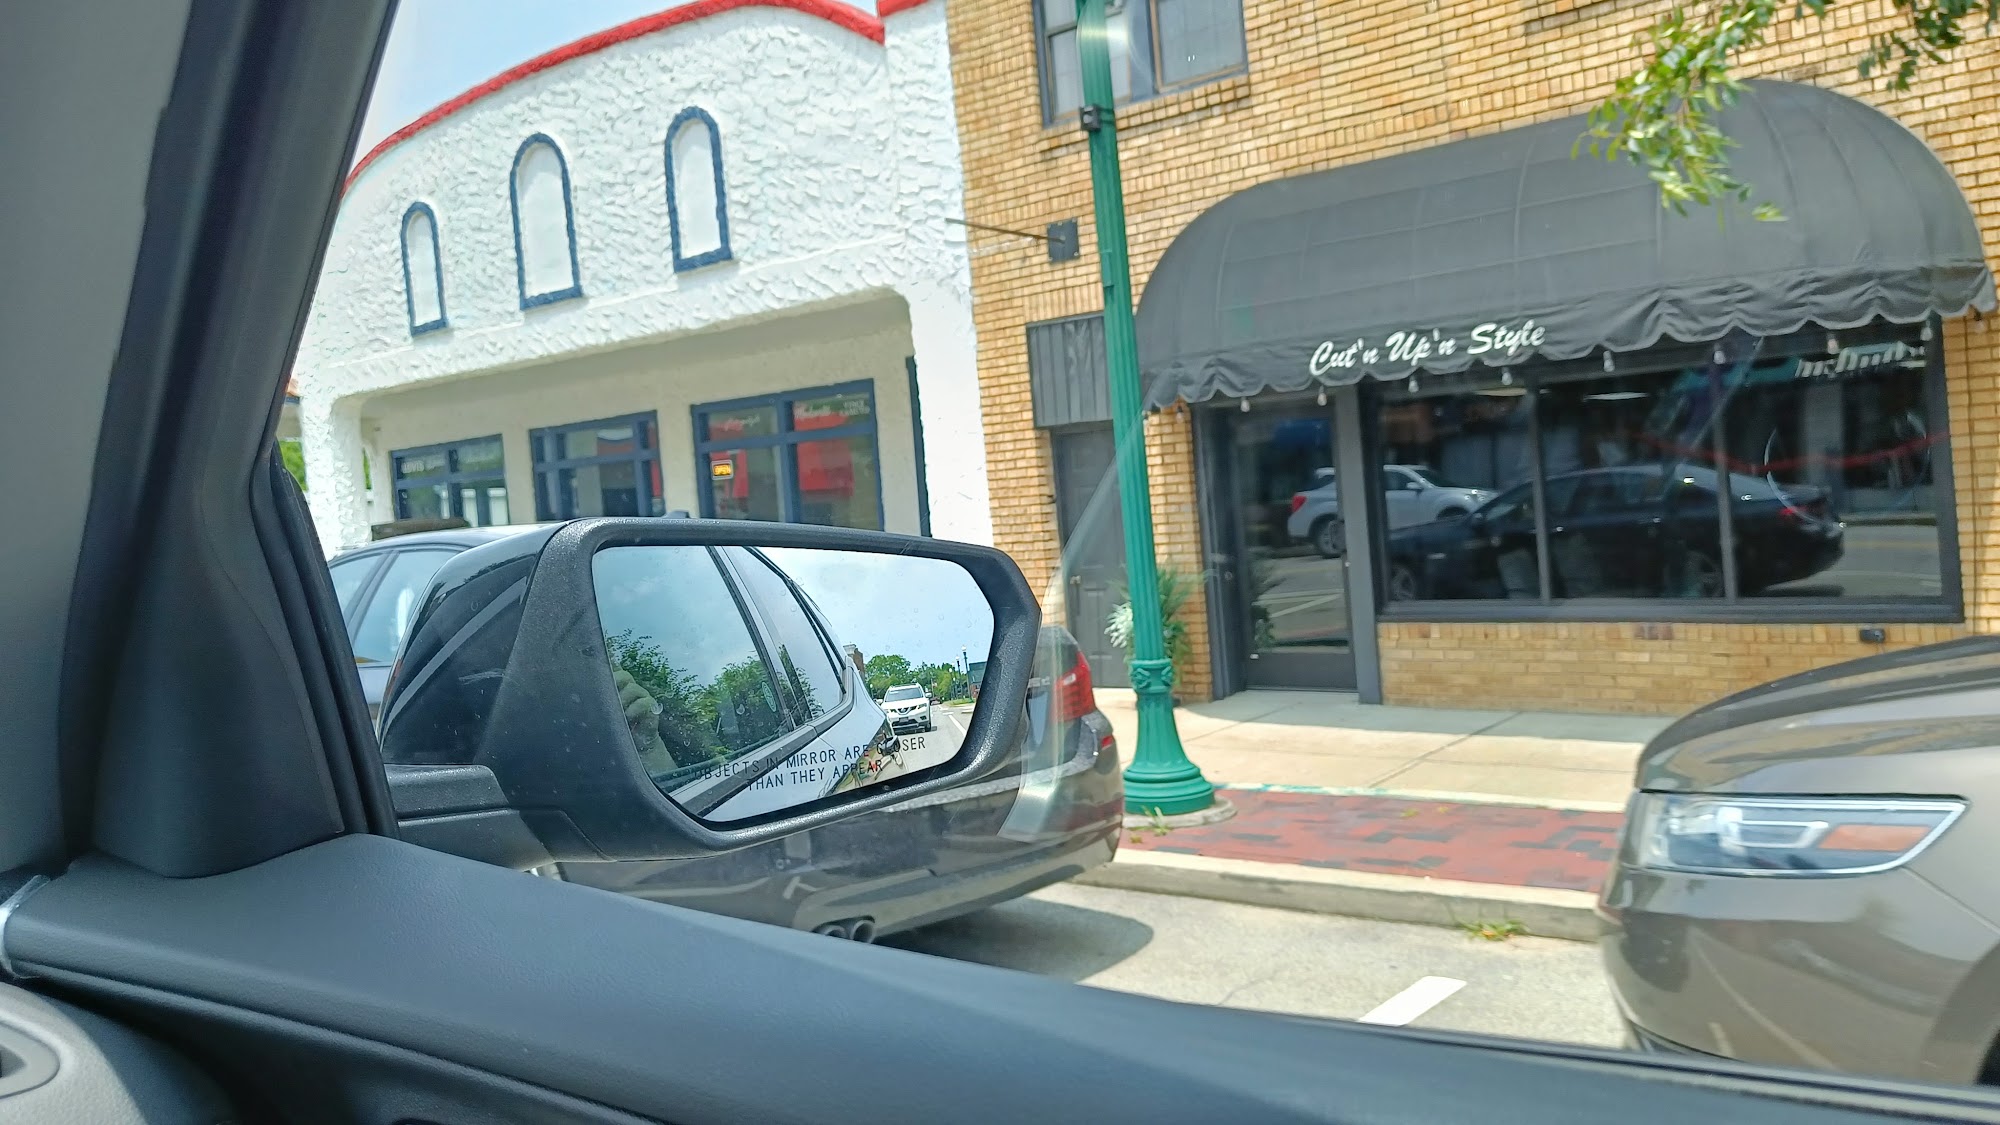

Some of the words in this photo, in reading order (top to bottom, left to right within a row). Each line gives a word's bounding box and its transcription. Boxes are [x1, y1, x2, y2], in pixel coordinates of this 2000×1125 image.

[1309, 338, 1380, 376] Cut'n
[1385, 328, 1456, 366] Up'n
[1467, 319, 1546, 357] Style
[694, 760, 760, 781] OBJECTS
[766, 757, 779, 770] IN
[786, 749, 836, 769] MIRROR
[844, 745, 869, 760] ARE
[877, 736, 926, 755] COSER
[747, 773, 783, 791] THAN
[792, 768, 824, 784] THEY
[832, 759, 883, 778] APPEAR
